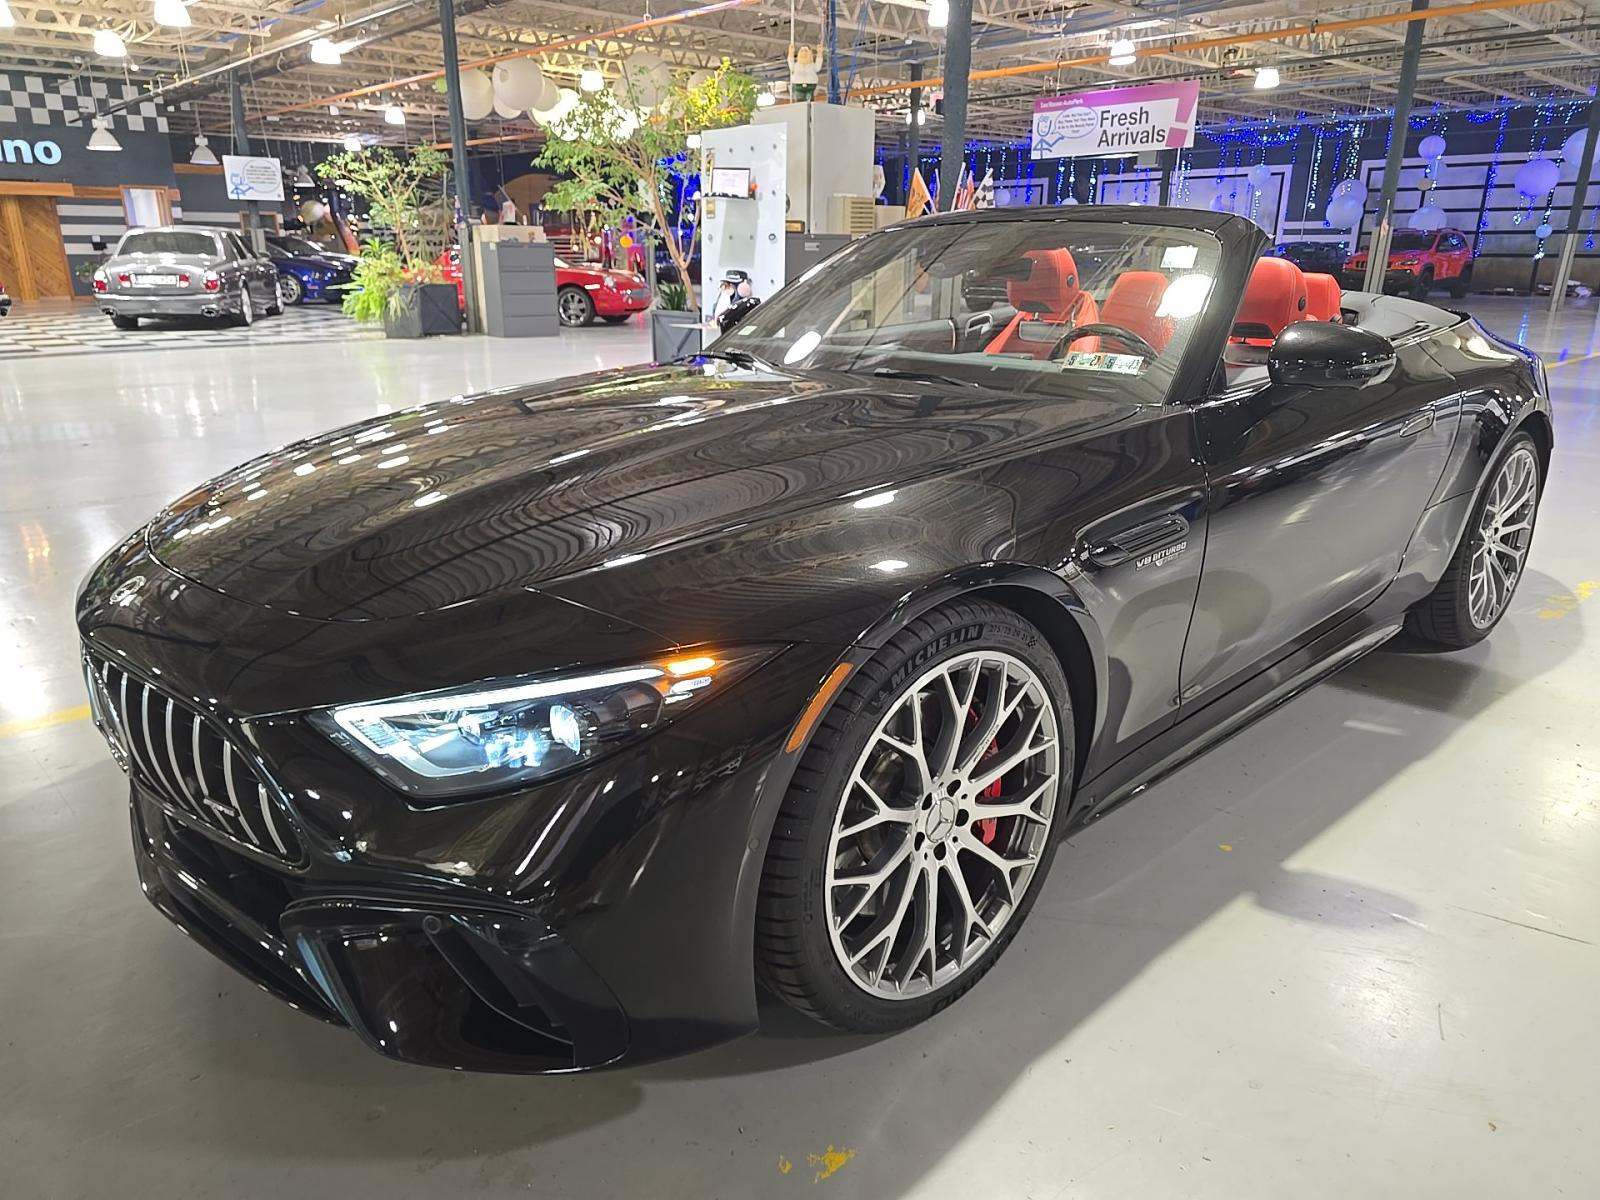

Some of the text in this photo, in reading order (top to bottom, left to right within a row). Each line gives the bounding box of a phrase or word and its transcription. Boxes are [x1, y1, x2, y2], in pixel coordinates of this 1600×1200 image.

[1099, 106, 1149, 128] Fresh
[1097, 125, 1166, 148] Arrivals
[0, 138, 62, 165] no
[890, 625, 980, 689] MICHELIN
